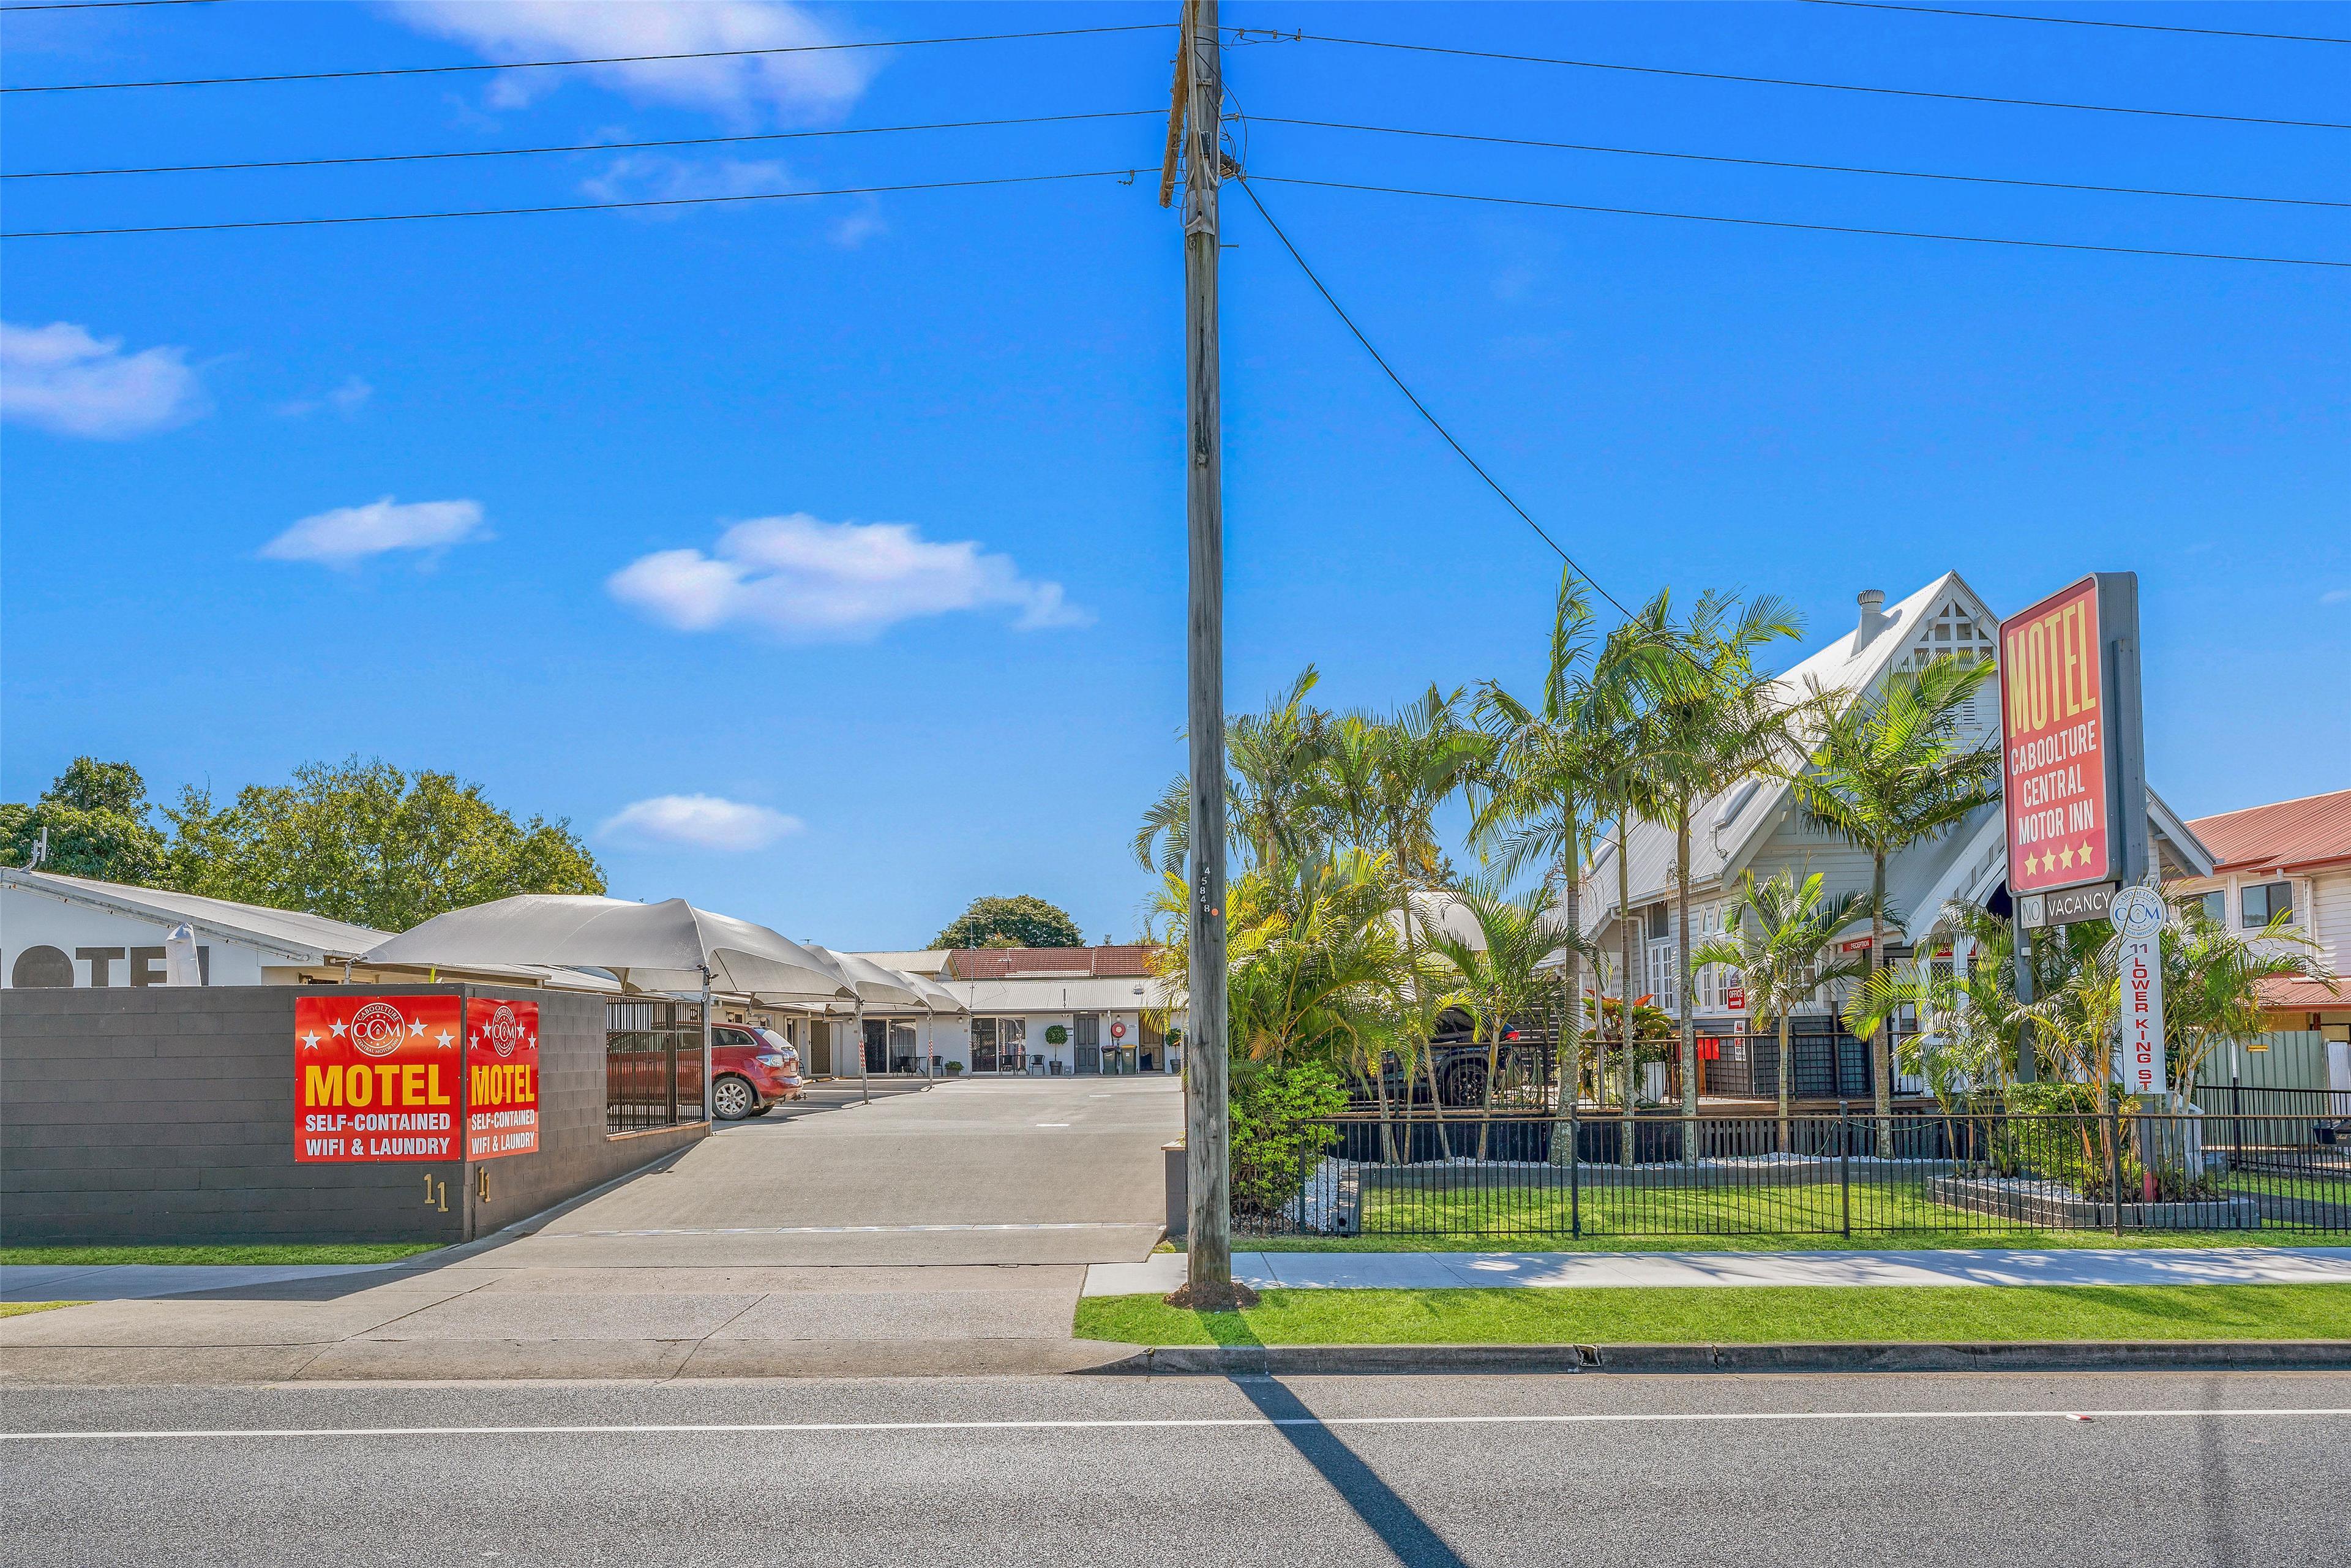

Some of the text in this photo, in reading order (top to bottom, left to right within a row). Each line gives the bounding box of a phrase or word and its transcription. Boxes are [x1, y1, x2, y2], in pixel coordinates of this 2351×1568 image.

[2008, 600, 2096, 738] MOTEL
[2011, 720, 2096, 776] CABOOLTURE
[2023, 764, 2085, 808] CENTRAL
[2018, 798, 2094, 846] MOTOR INN
[1200, 866, 1210, 912] 45848
[2117, 891, 2159, 906] CABOOLTURE
[2023, 891, 2111, 922] NO VACANCY
[2115, 904, 2161, 924] CCM
[2119, 922, 2135, 936] CETRAL
[2136, 928, 2153, 936] MOTOR
[1729, 989, 1743, 998] OFFICE
[357, 1005, 400, 1022] CABOOLTURE
[2130, 943, 2153, 1091] 11 LOWER KING ST
[353, 1019, 402, 1041] CCM
[494, 1021, 514, 1042] CCM
[357, 1038, 375, 1053] CENTRAL
[306, 1065, 450, 1106] MOTEL
[471, 1064, 534, 1106] MOTEL
[306, 1113, 450, 1131] SELF-CONTAINED
[471, 1109, 534, 1131] SELF-CONTAINED
[306, 1137, 450, 1155] WIFI & LAUNDRY
[471, 1131, 534, 1155] WIFI & LAUNDRY
[424, 1174, 449, 1212] 11
[478, 1166, 490, 1204] 11
